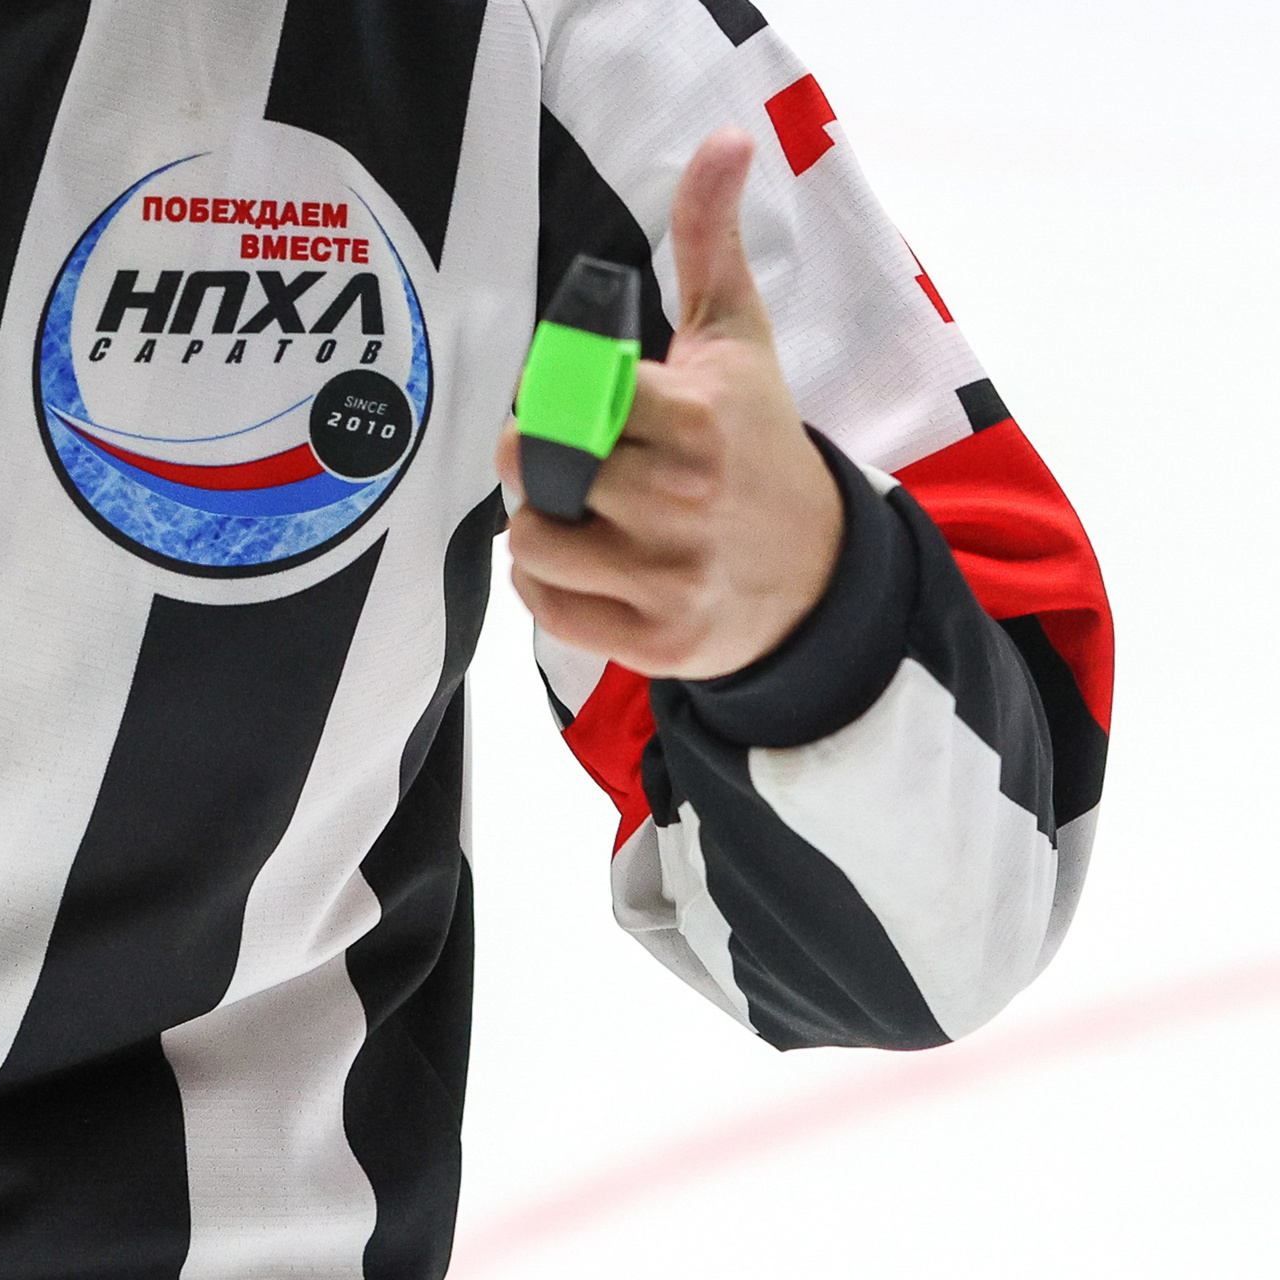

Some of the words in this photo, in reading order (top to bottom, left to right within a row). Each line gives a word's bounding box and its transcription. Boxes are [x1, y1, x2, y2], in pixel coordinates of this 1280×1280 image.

[142, 196, 348, 231] ПОБЕЖДАЕМ
[240, 233, 370, 264] ВМЕСТЕ
[95, 269, 385, 336] НПХЛ
[88, 337, 383, 365] САРАТОВ
[344, 395, 389, 416] SINCE
[327, 411, 396, 439] 2010
